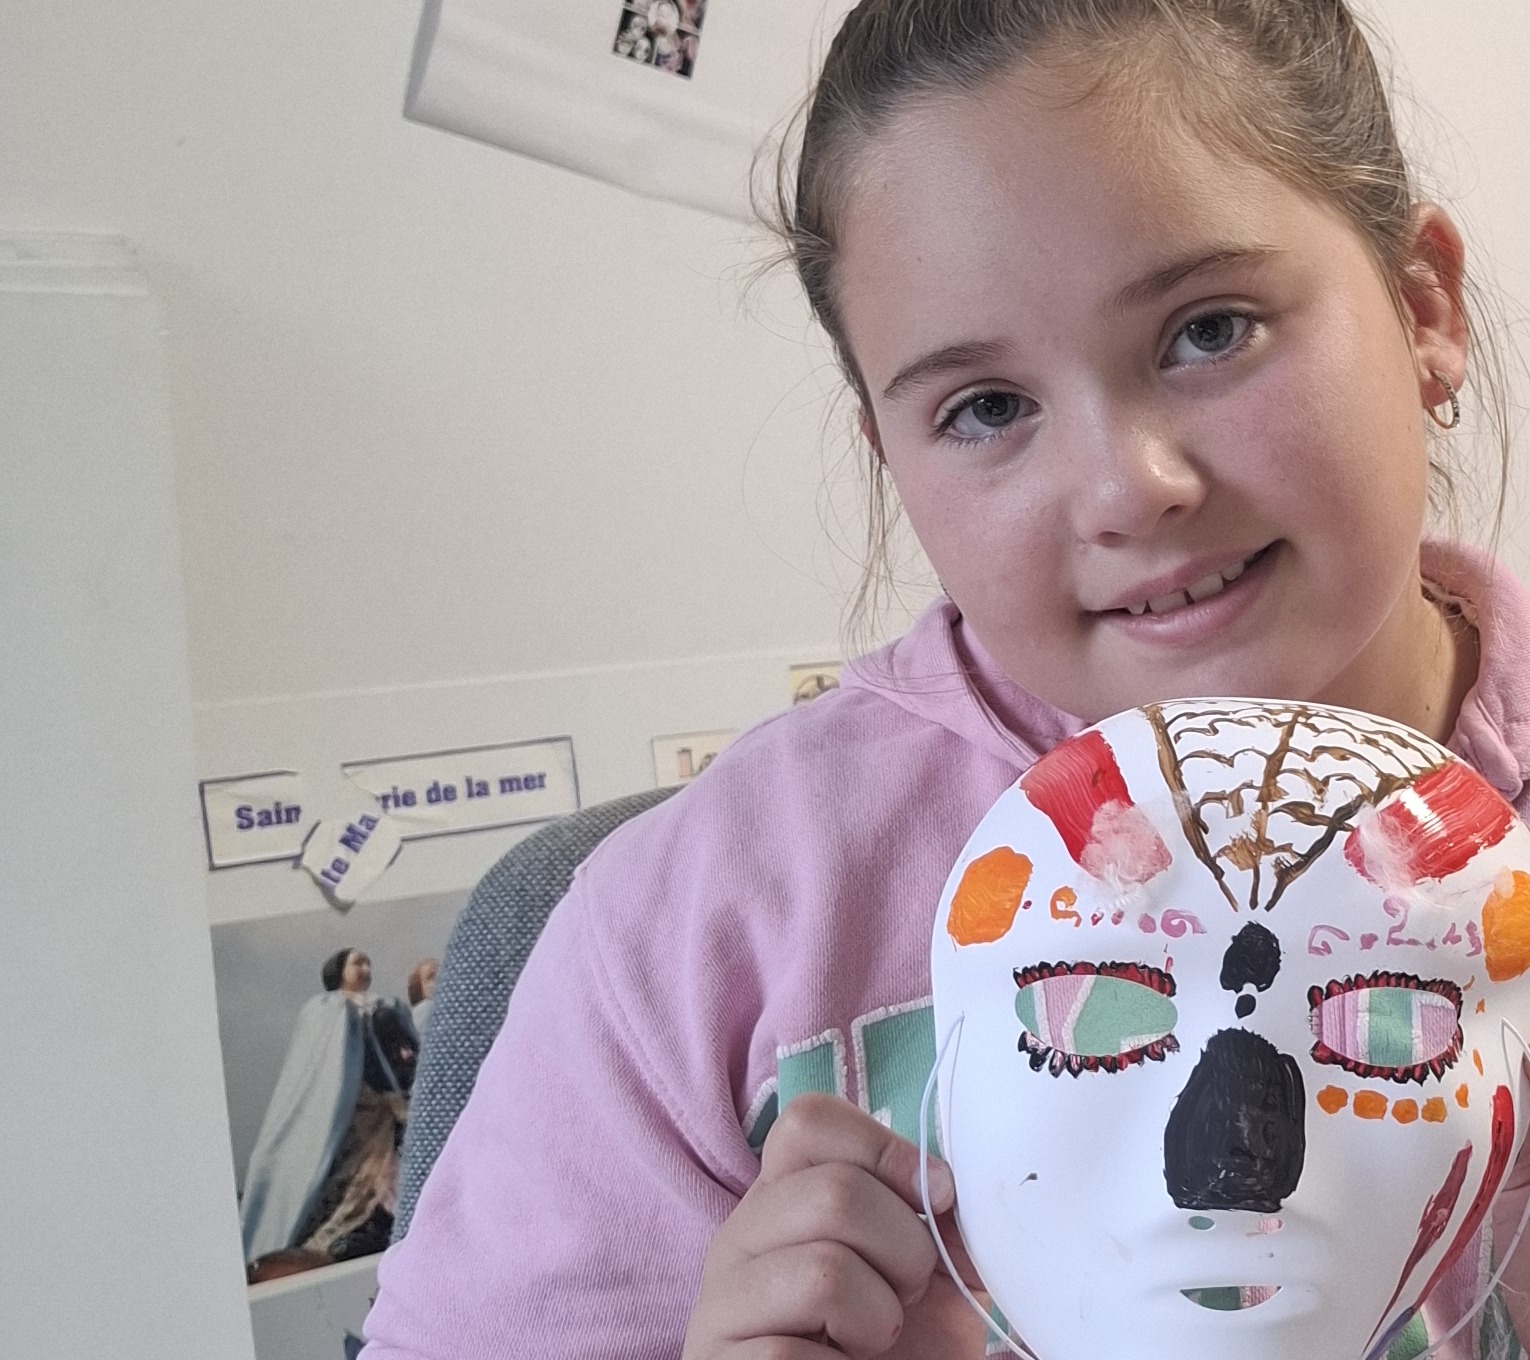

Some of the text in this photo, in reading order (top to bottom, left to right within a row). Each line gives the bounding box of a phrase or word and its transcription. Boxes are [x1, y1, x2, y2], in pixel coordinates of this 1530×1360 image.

[235, 802, 302, 830] Sain
[339, 813, 380, 854] Ma
[426, 781, 458, 804] de
[465, 776, 490, 799] la
[500, 771, 547, 794] mer
